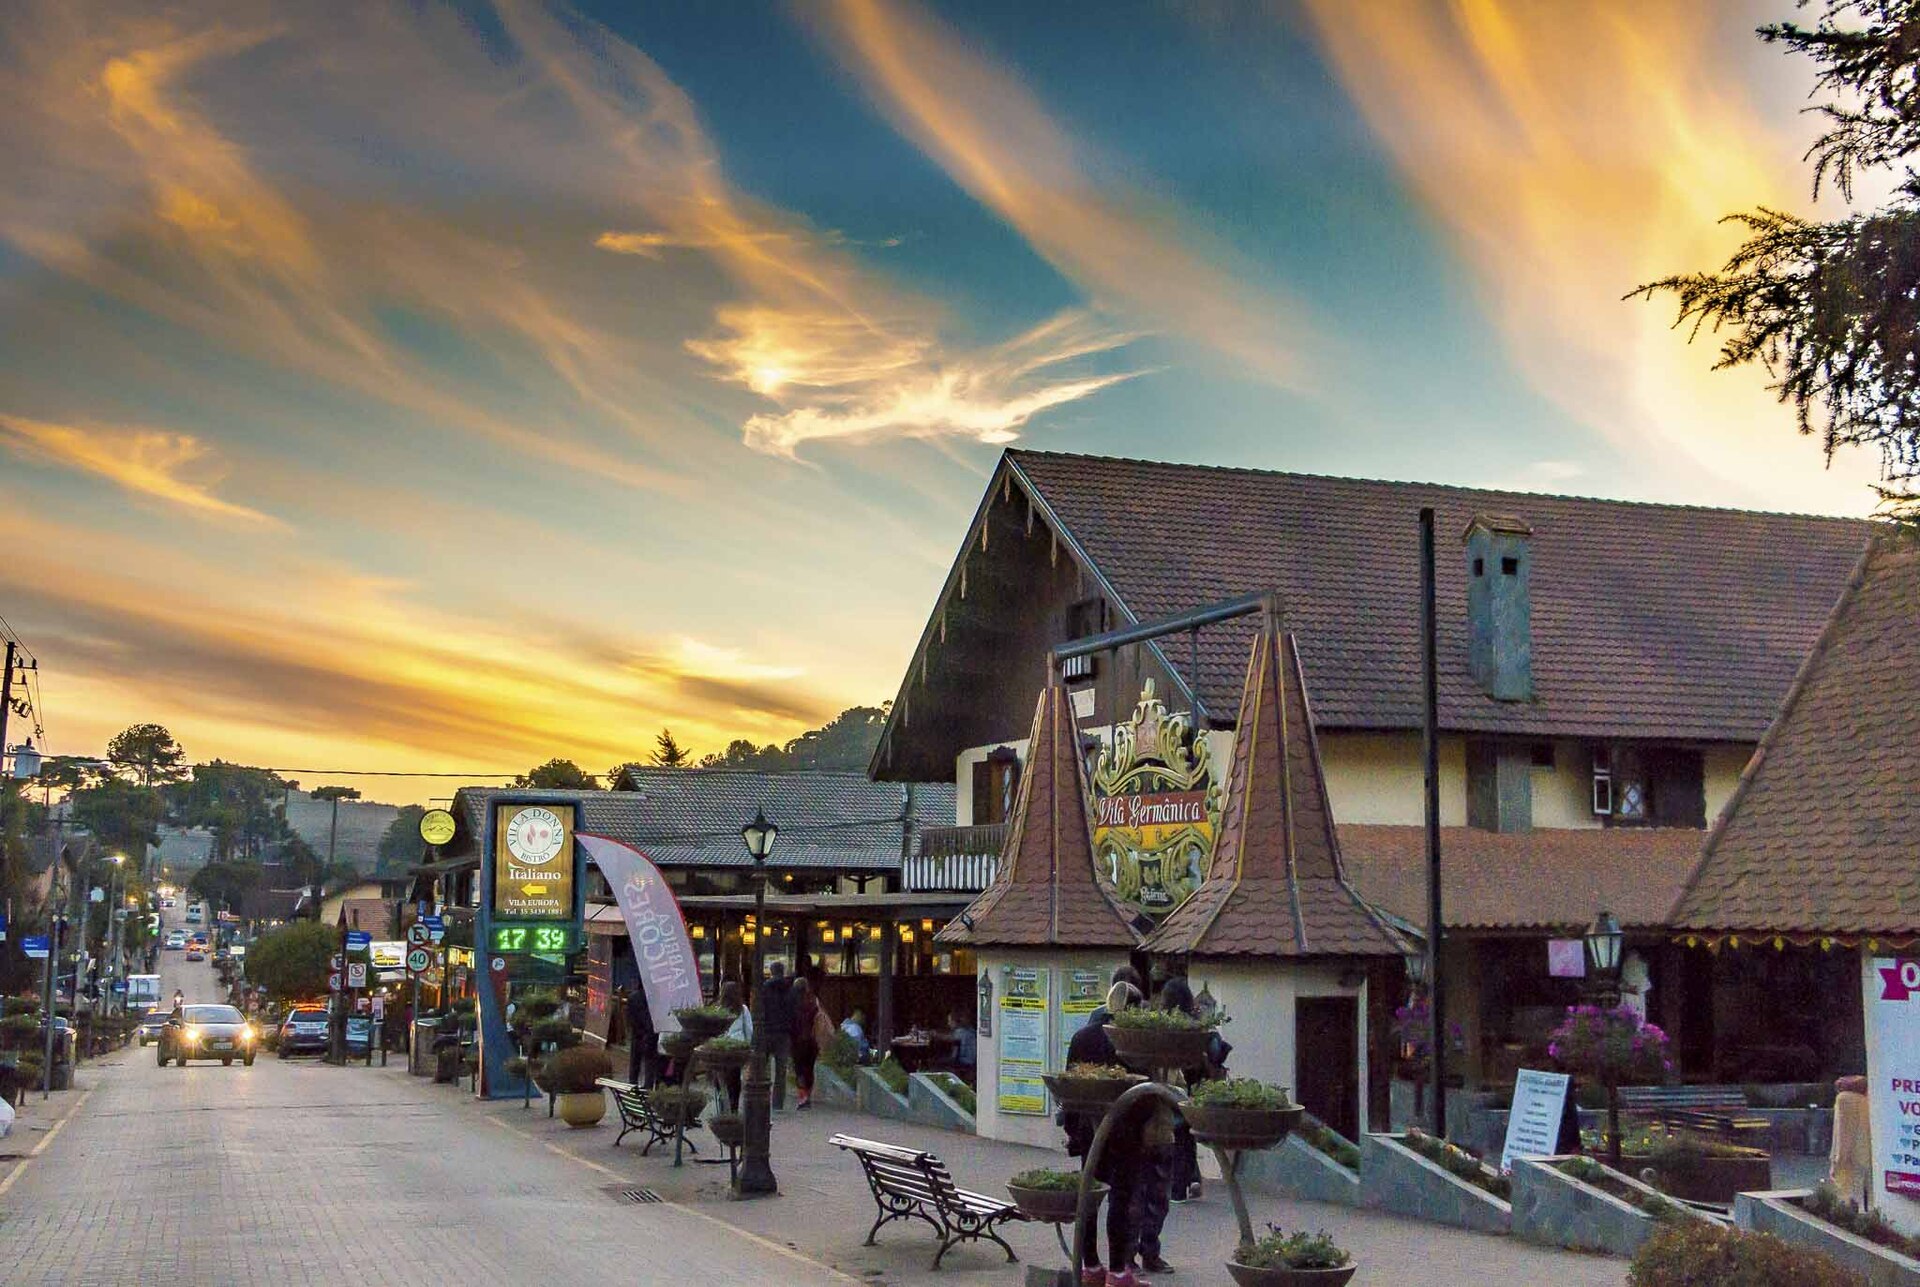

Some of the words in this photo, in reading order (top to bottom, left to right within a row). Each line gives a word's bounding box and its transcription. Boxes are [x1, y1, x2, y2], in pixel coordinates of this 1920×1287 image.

[1128, 794, 1200, 828] Germânica
[510, 869, 562, 880] Italiano
[498, 929, 526, 949] 17
[536, 929, 565, 949] 39
[410, 953, 426, 964] 40
